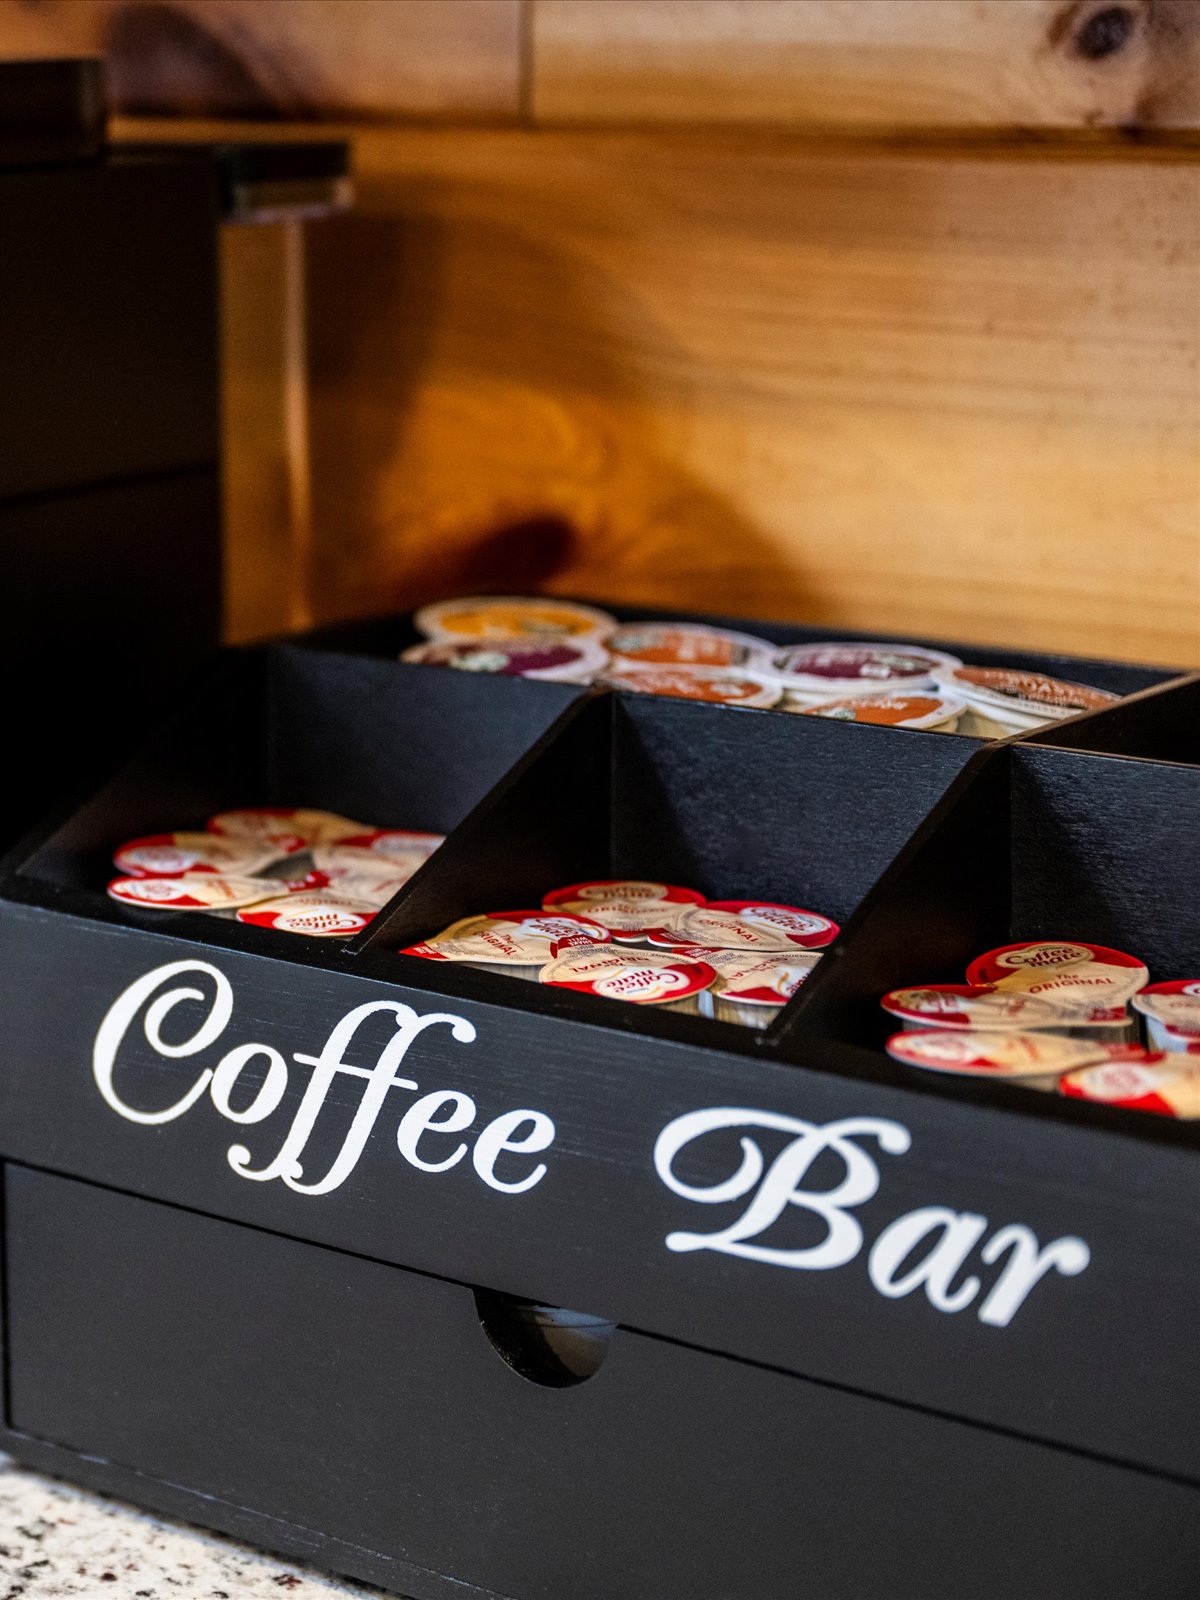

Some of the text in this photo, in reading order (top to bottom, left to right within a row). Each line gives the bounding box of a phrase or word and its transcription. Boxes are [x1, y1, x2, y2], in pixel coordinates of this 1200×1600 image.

[1005, 948, 1075, 967] Coffee
[1030, 951, 1084, 968] mate
[605, 969, 656, 988] mate
[614, 973, 680, 993] Coffee
[1028, 977, 1116, 994] ORIGINAL
[1055, 973, 1079, 981] The
[92, 959, 1090, 1327] Coffee Bar
